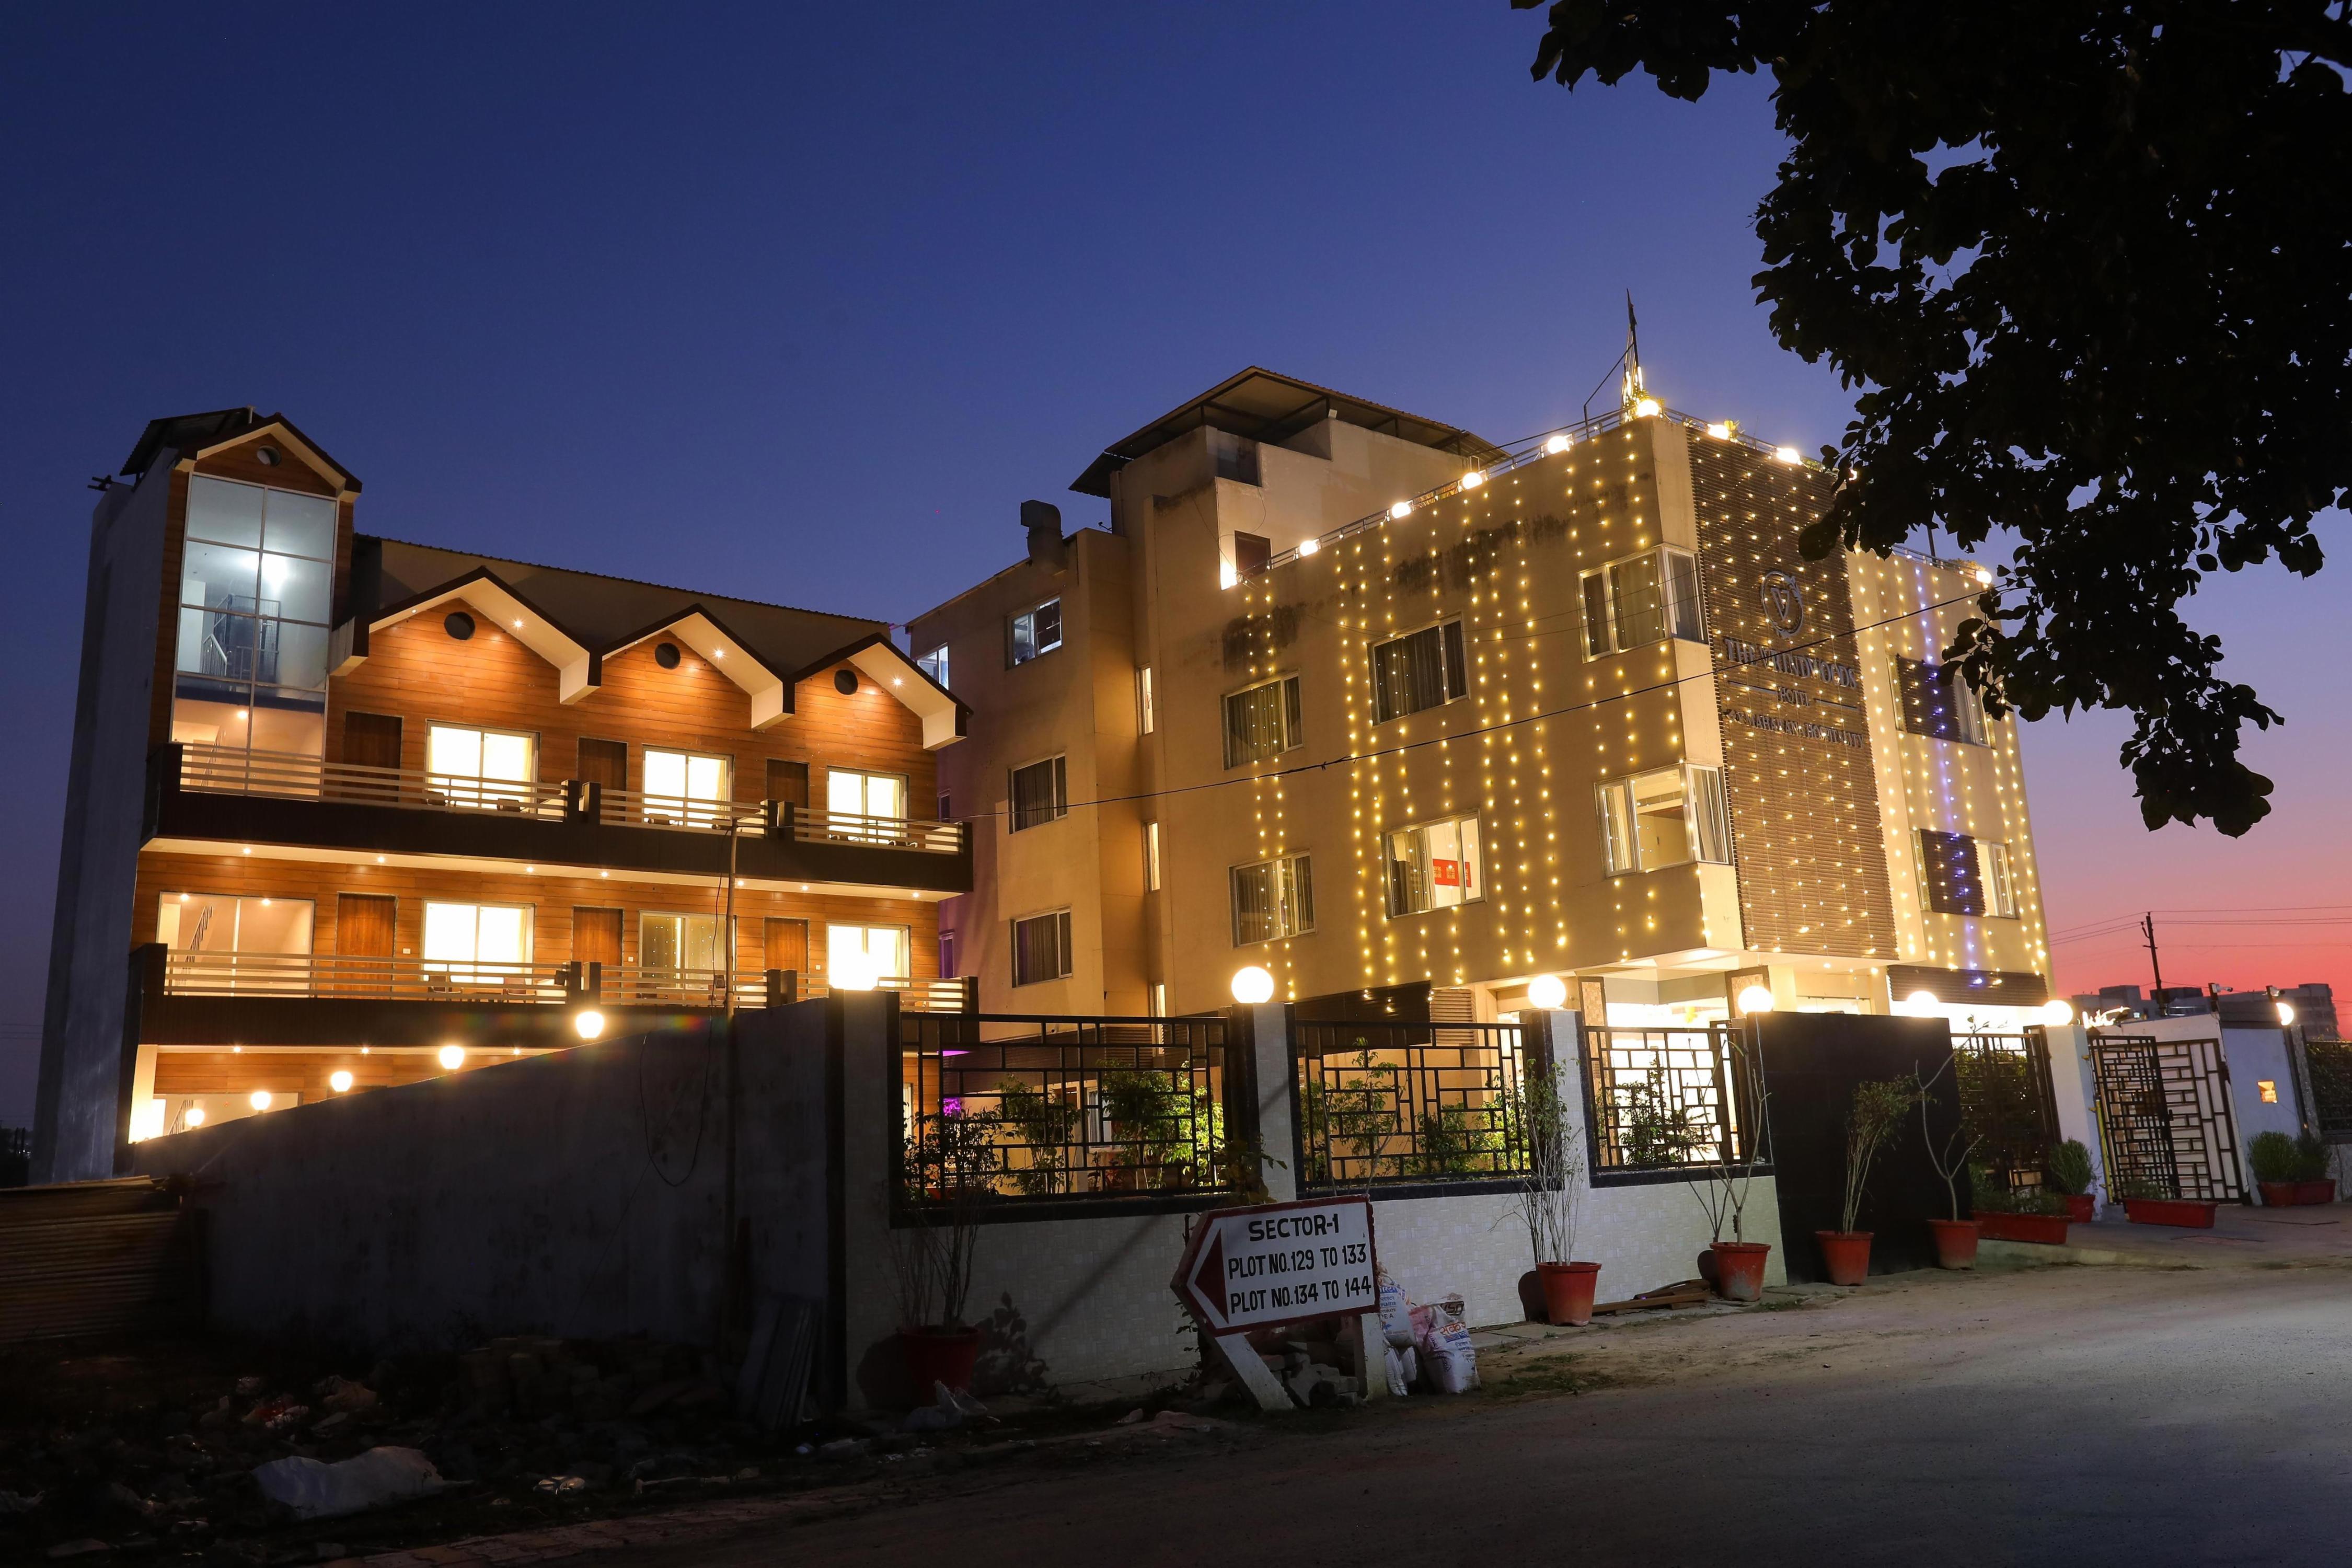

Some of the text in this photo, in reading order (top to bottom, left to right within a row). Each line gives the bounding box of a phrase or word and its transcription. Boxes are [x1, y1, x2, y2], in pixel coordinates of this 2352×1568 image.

[1778, 686, 1810, 707] HOTEL
[1248, 1213, 1339, 1242] SECTOR-1
[1228, 1255, 1266, 1279] PLOT
[1320, 1247, 1338, 1268] TO
[1342, 1243, 1366, 1265] 133
[1230, 1289, 1266, 1314] PLOT
[1322, 1280, 1339, 1300] TO
[1345, 1275, 1371, 1298] 144
